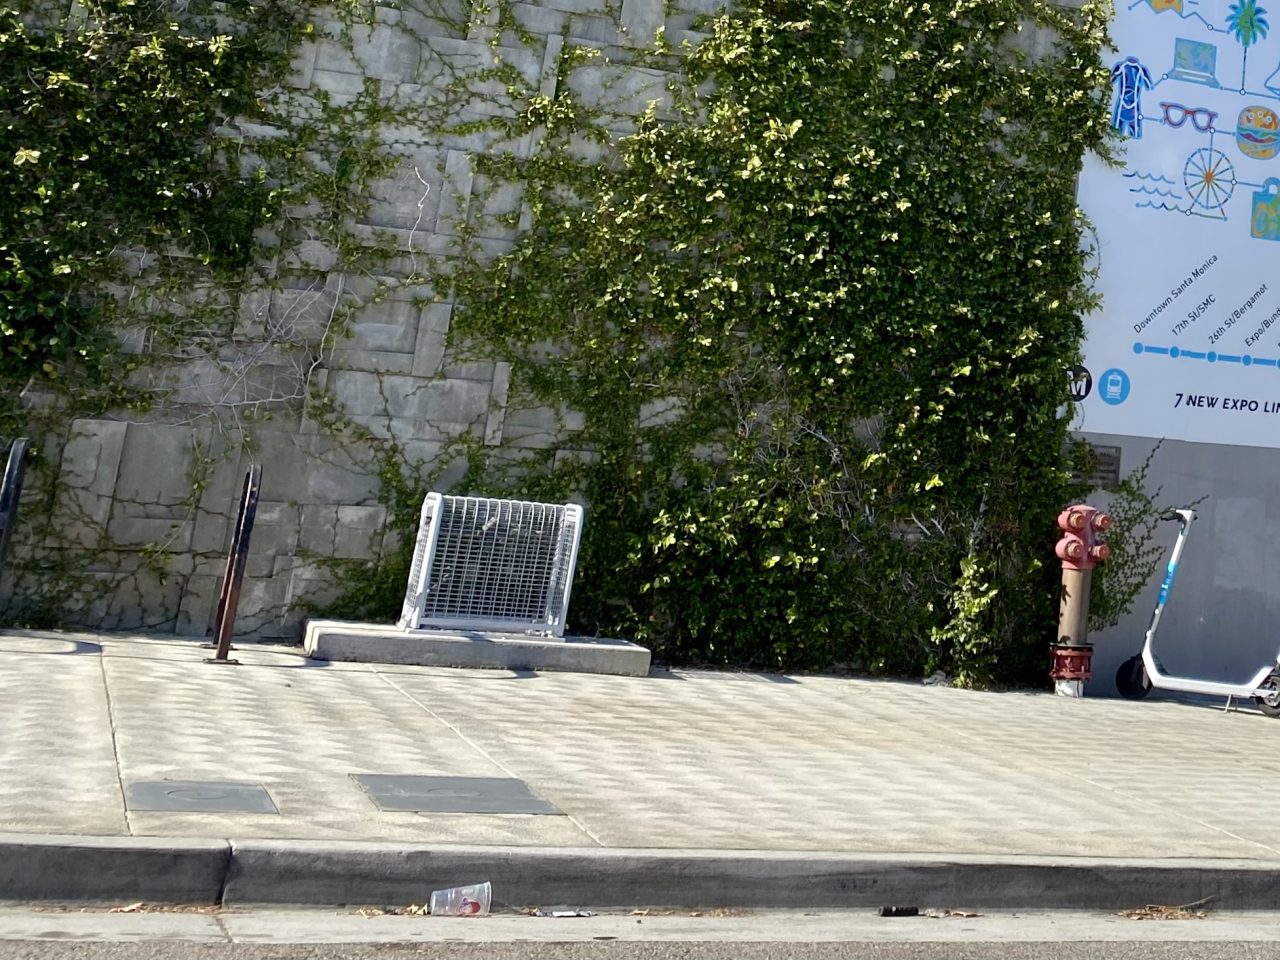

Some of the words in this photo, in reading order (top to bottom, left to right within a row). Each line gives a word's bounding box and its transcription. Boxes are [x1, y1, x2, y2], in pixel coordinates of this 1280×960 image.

[1133, 296, 1173, 334] Downtown
[1171, 275, 1194, 300] Santa
[1191, 254, 1219, 280] Monica
[1171, 318, 1190, 337] 17th
[1187, 293, 1217, 323] St/SMC
[1208, 325, 1226, 345] 26th
[1224, 283, 1269, 330] St/Bergamot
[1174, 393, 1183, 409] 7
[1186, 394, 1219, 409] NEW
[1222, 398, 1259, 412] EXPO
